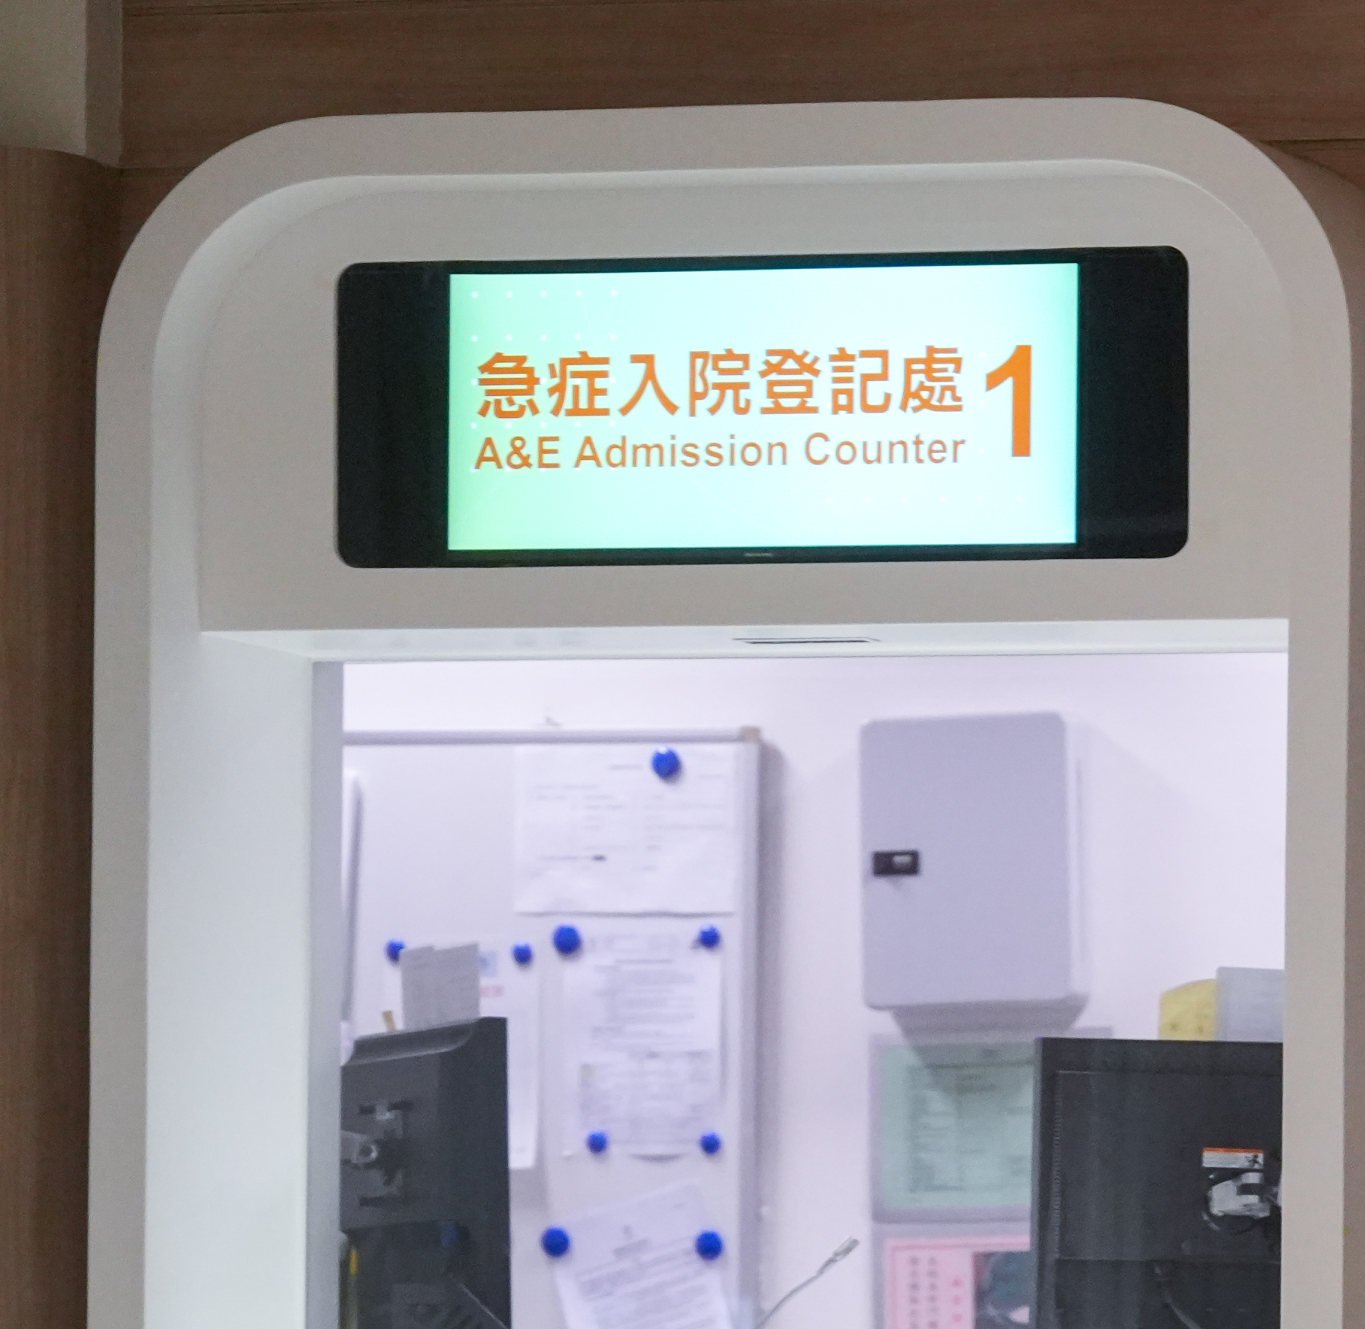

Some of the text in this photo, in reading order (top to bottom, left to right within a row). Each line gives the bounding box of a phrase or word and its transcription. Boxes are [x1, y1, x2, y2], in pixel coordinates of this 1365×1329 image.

[476, 344, 1033, 458] 急症入院登記處 1
[474, 432, 967, 470] A&E Admission Counter
